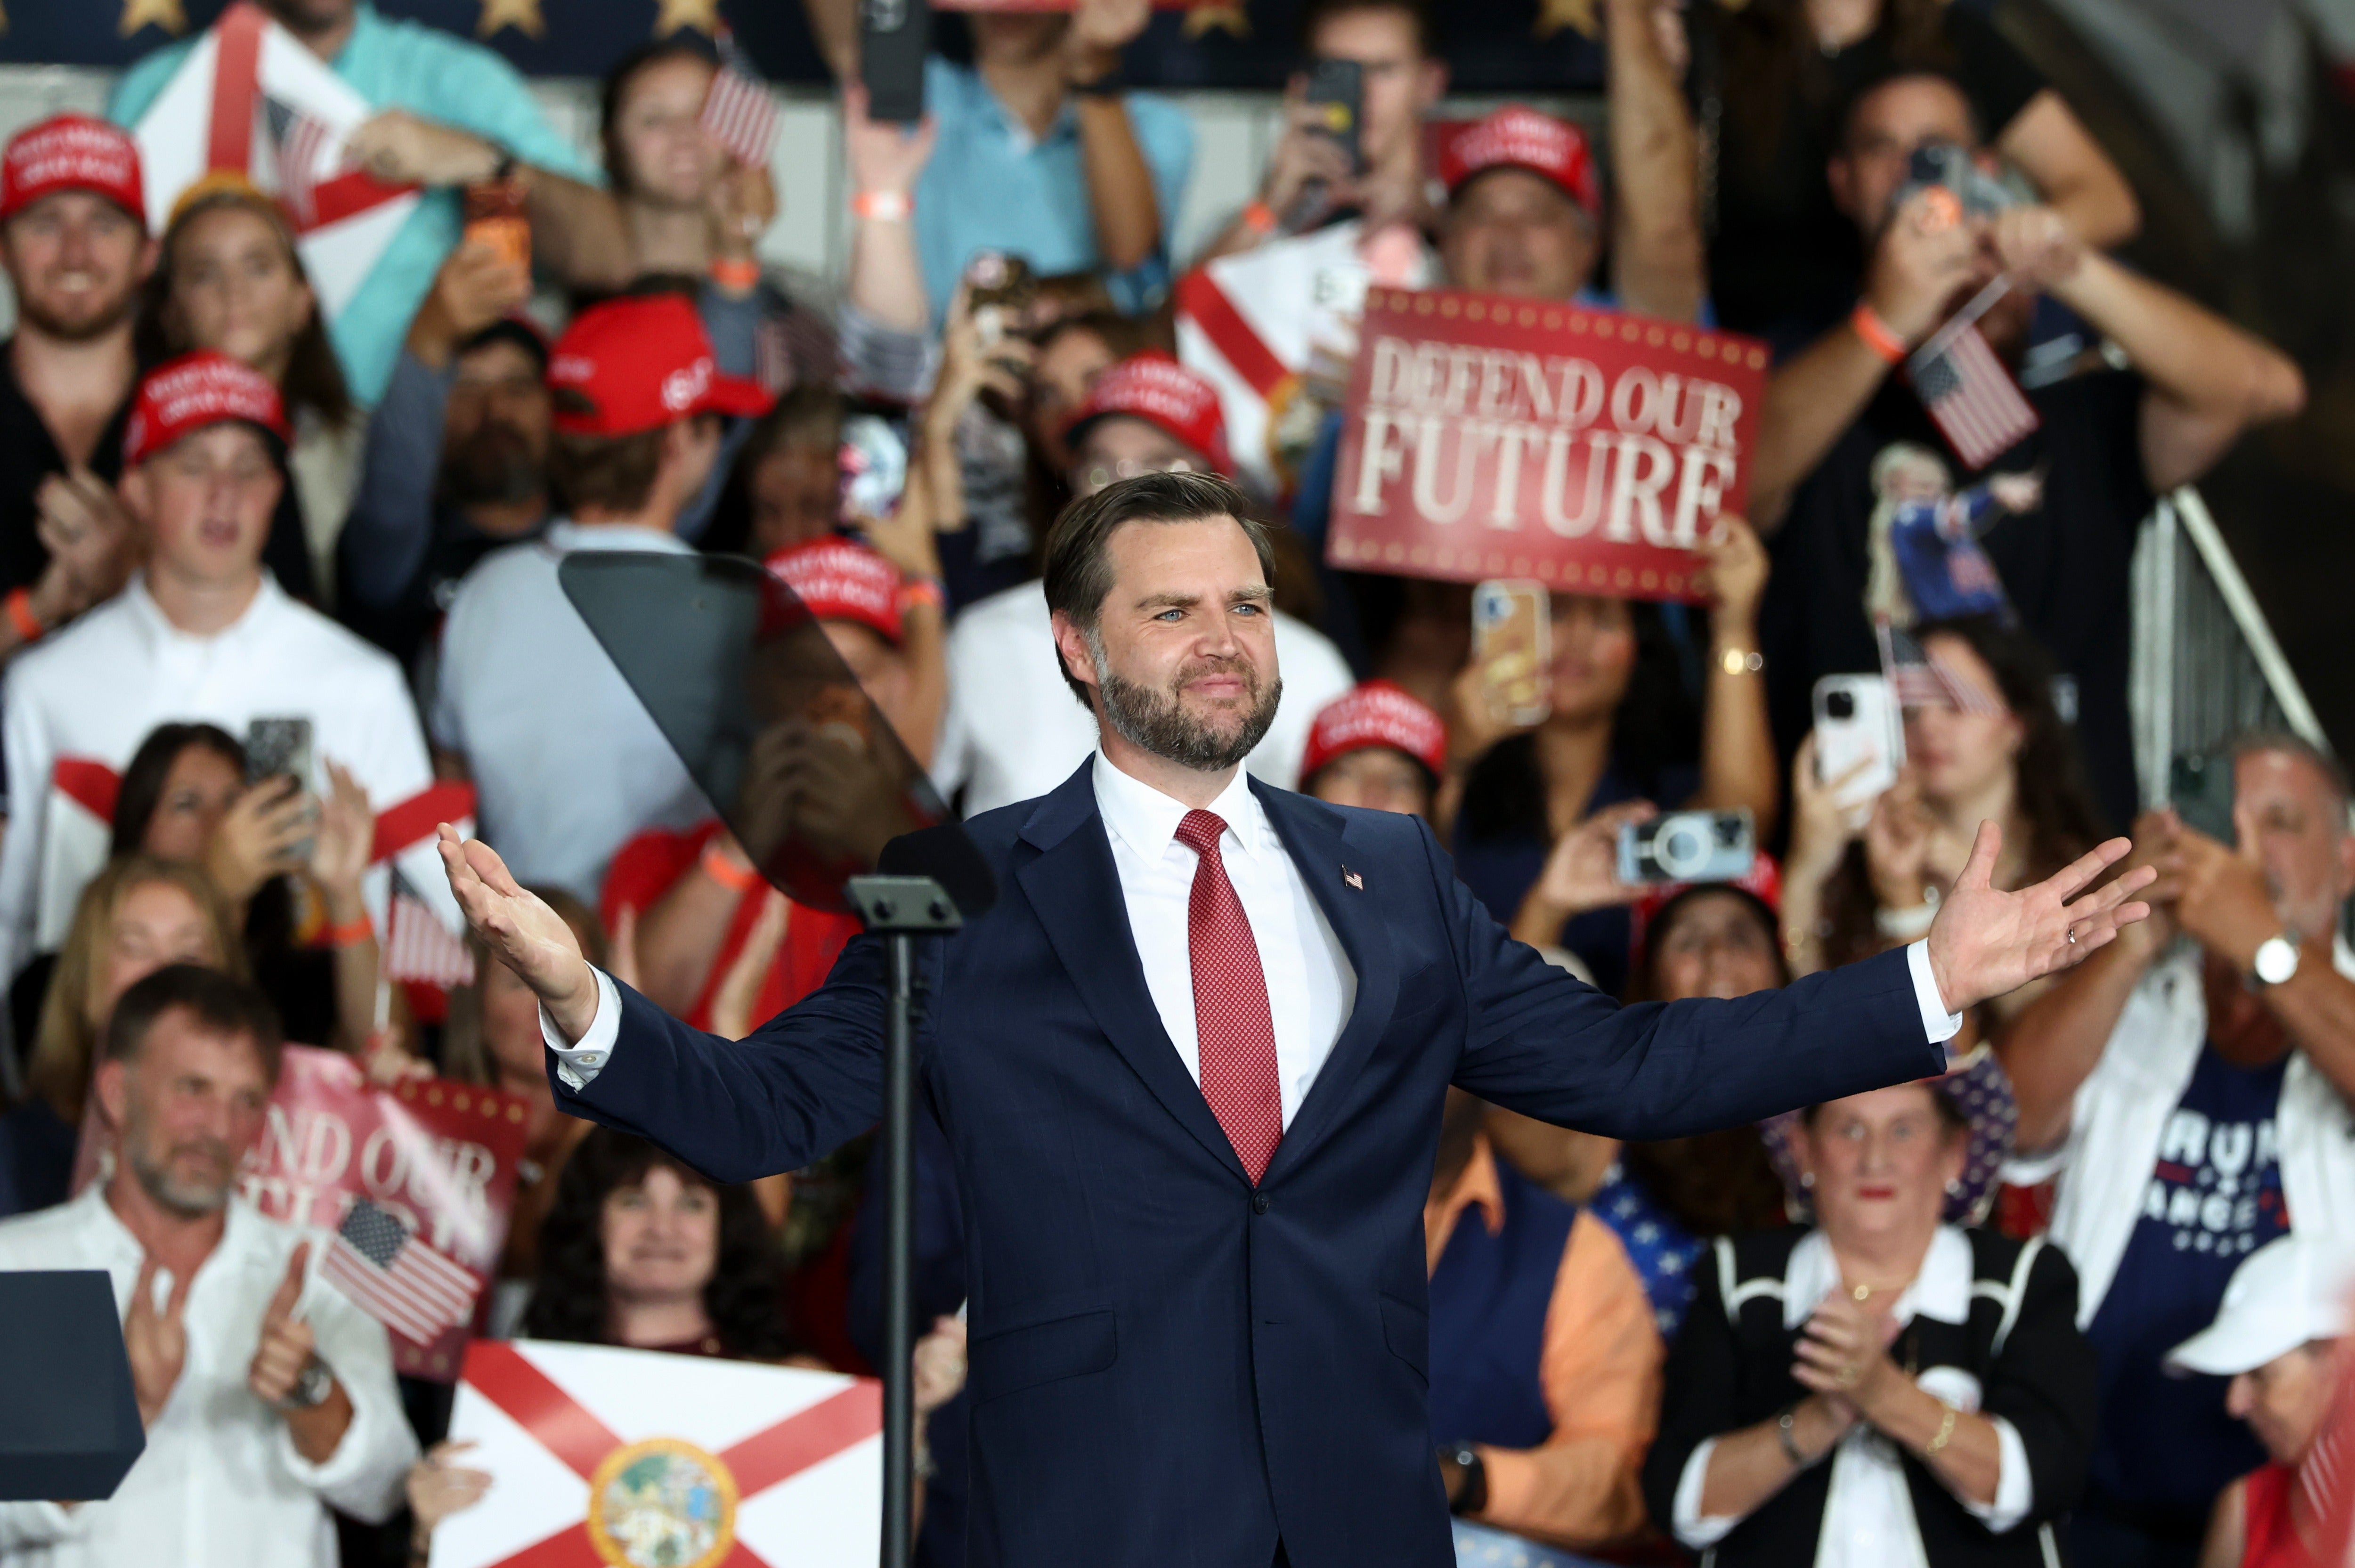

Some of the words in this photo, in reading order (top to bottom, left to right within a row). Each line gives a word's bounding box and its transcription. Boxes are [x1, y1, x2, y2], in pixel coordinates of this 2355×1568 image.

[1368, 335, 1604, 428] DEFEND
[1611, 366, 1743, 450] OUR
[1353, 407, 1737, 550] FUTURE
